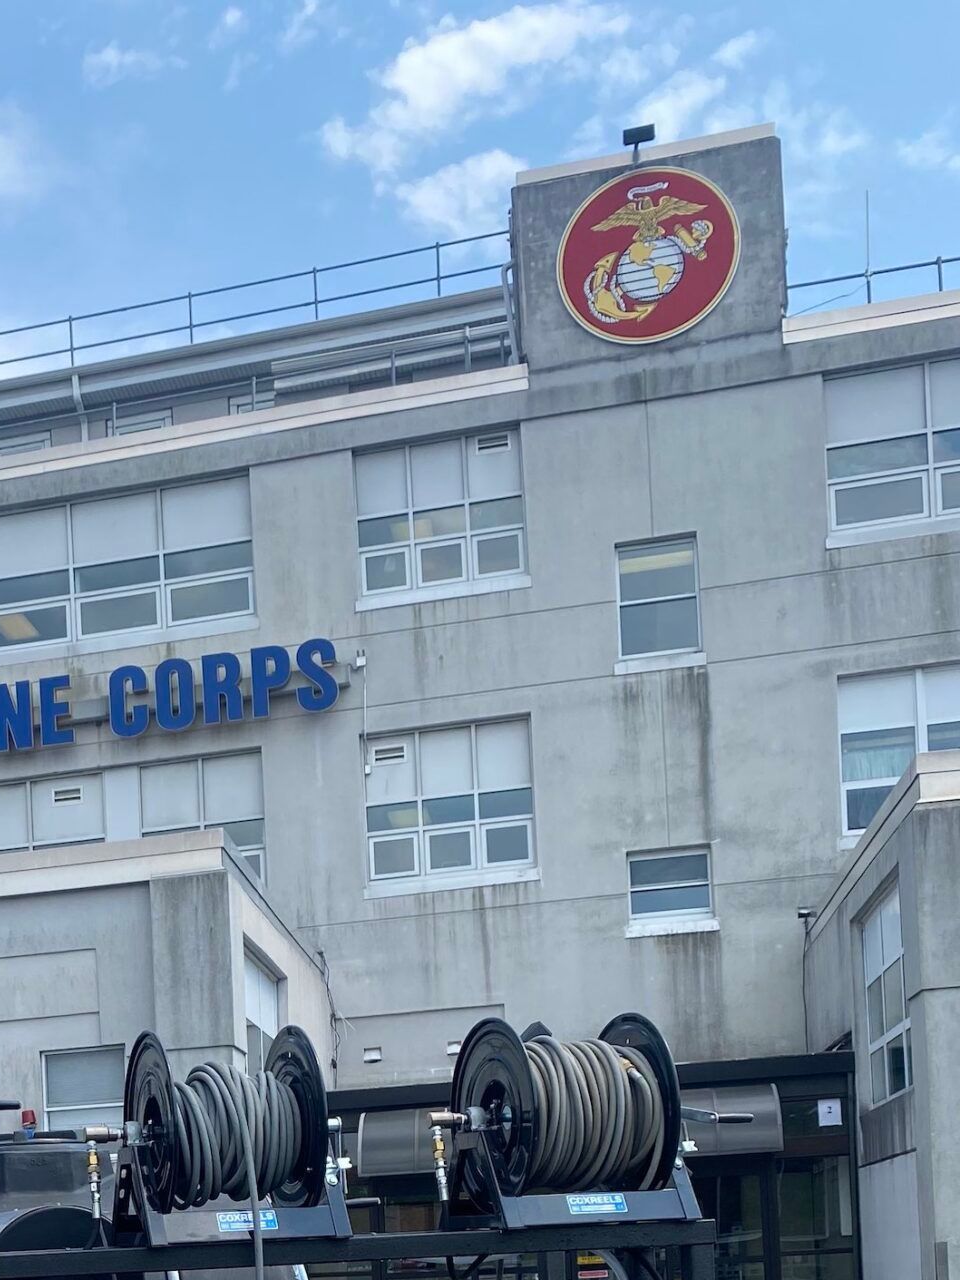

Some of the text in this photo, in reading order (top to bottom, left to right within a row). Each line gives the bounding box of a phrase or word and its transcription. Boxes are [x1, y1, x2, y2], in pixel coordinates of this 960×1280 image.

[108, 637, 341, 740] CORPS
[569, 1195, 622, 1204] COXREELS
[219, 1212, 274, 1222] COXRELS
